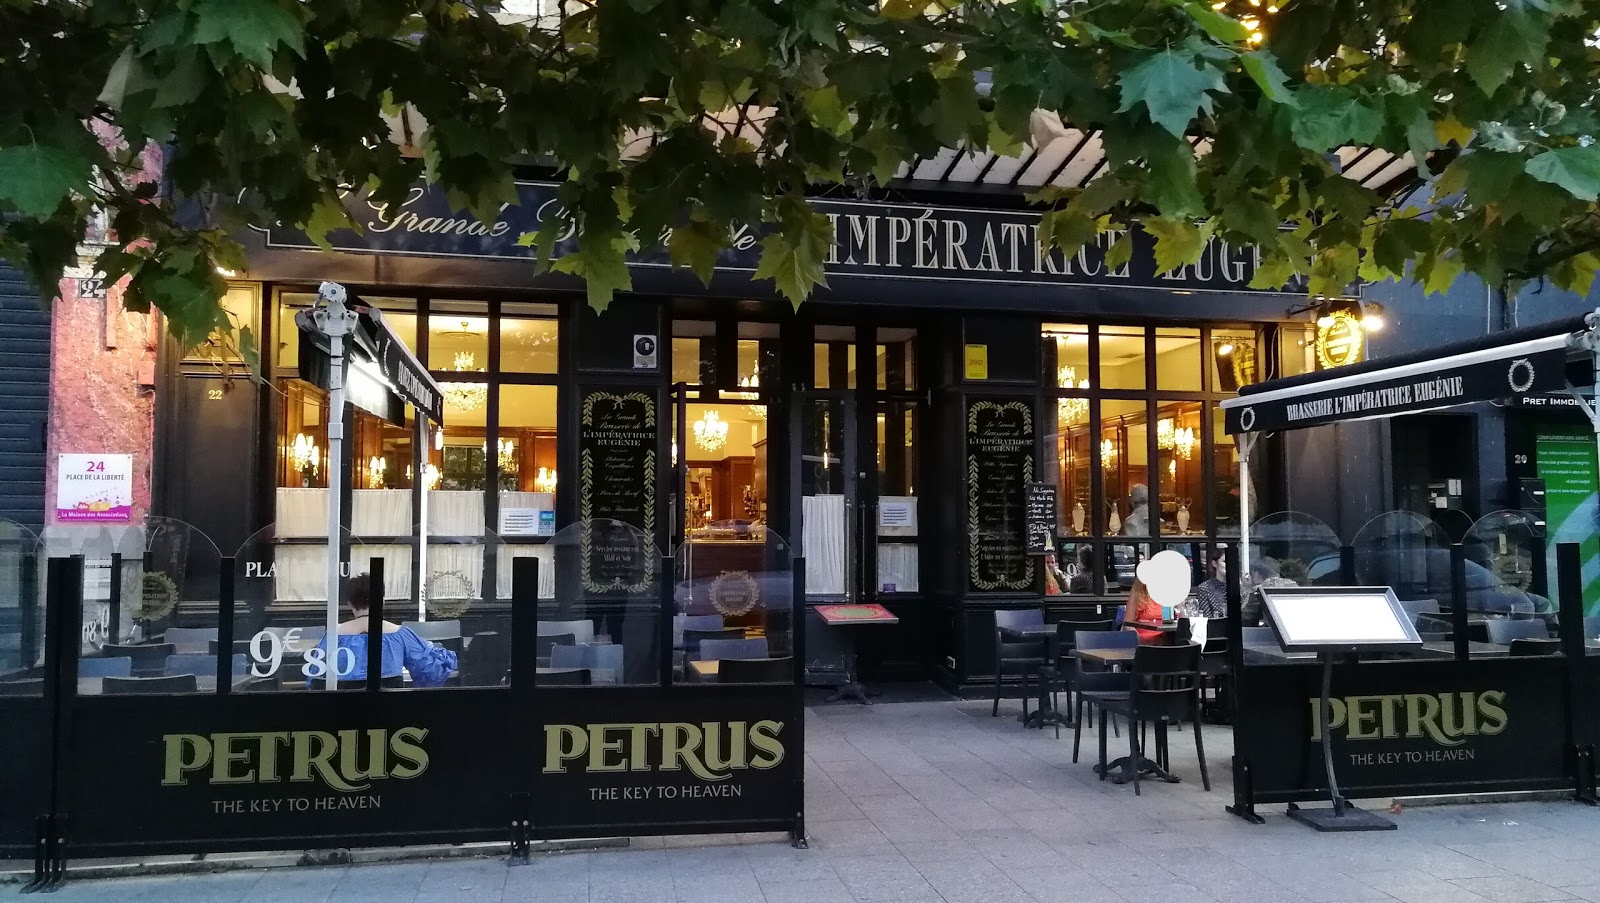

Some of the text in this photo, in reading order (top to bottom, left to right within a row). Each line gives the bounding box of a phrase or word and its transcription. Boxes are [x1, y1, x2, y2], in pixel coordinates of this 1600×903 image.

[208, 389, 222, 400] 22
[1286, 375, 1464, 422] BRASSERIE L'IMPÉRATRICE EUGÉNIE
[1522, 397, 1547, 405] PRET
[583, 429, 655, 439] L'IMPÉRATRICE
[86, 461, 105, 472] 24
[1514, 454, 1528, 464] 20
[101, 473, 125, 481] LIBERTÉ
[245, 561, 284, 578] PLA
[1309, 689, 1508, 747] PETRUS
[542, 719, 785, 782] PETRUS
[1350, 748, 1475, 766] THE KEY TO HEAVEN
[161, 726, 430, 793] PETRUS
[589, 784, 742, 801] THE KEY TO HEAVEN
[212, 795, 381, 814] THE KEY TO HEAVEN
